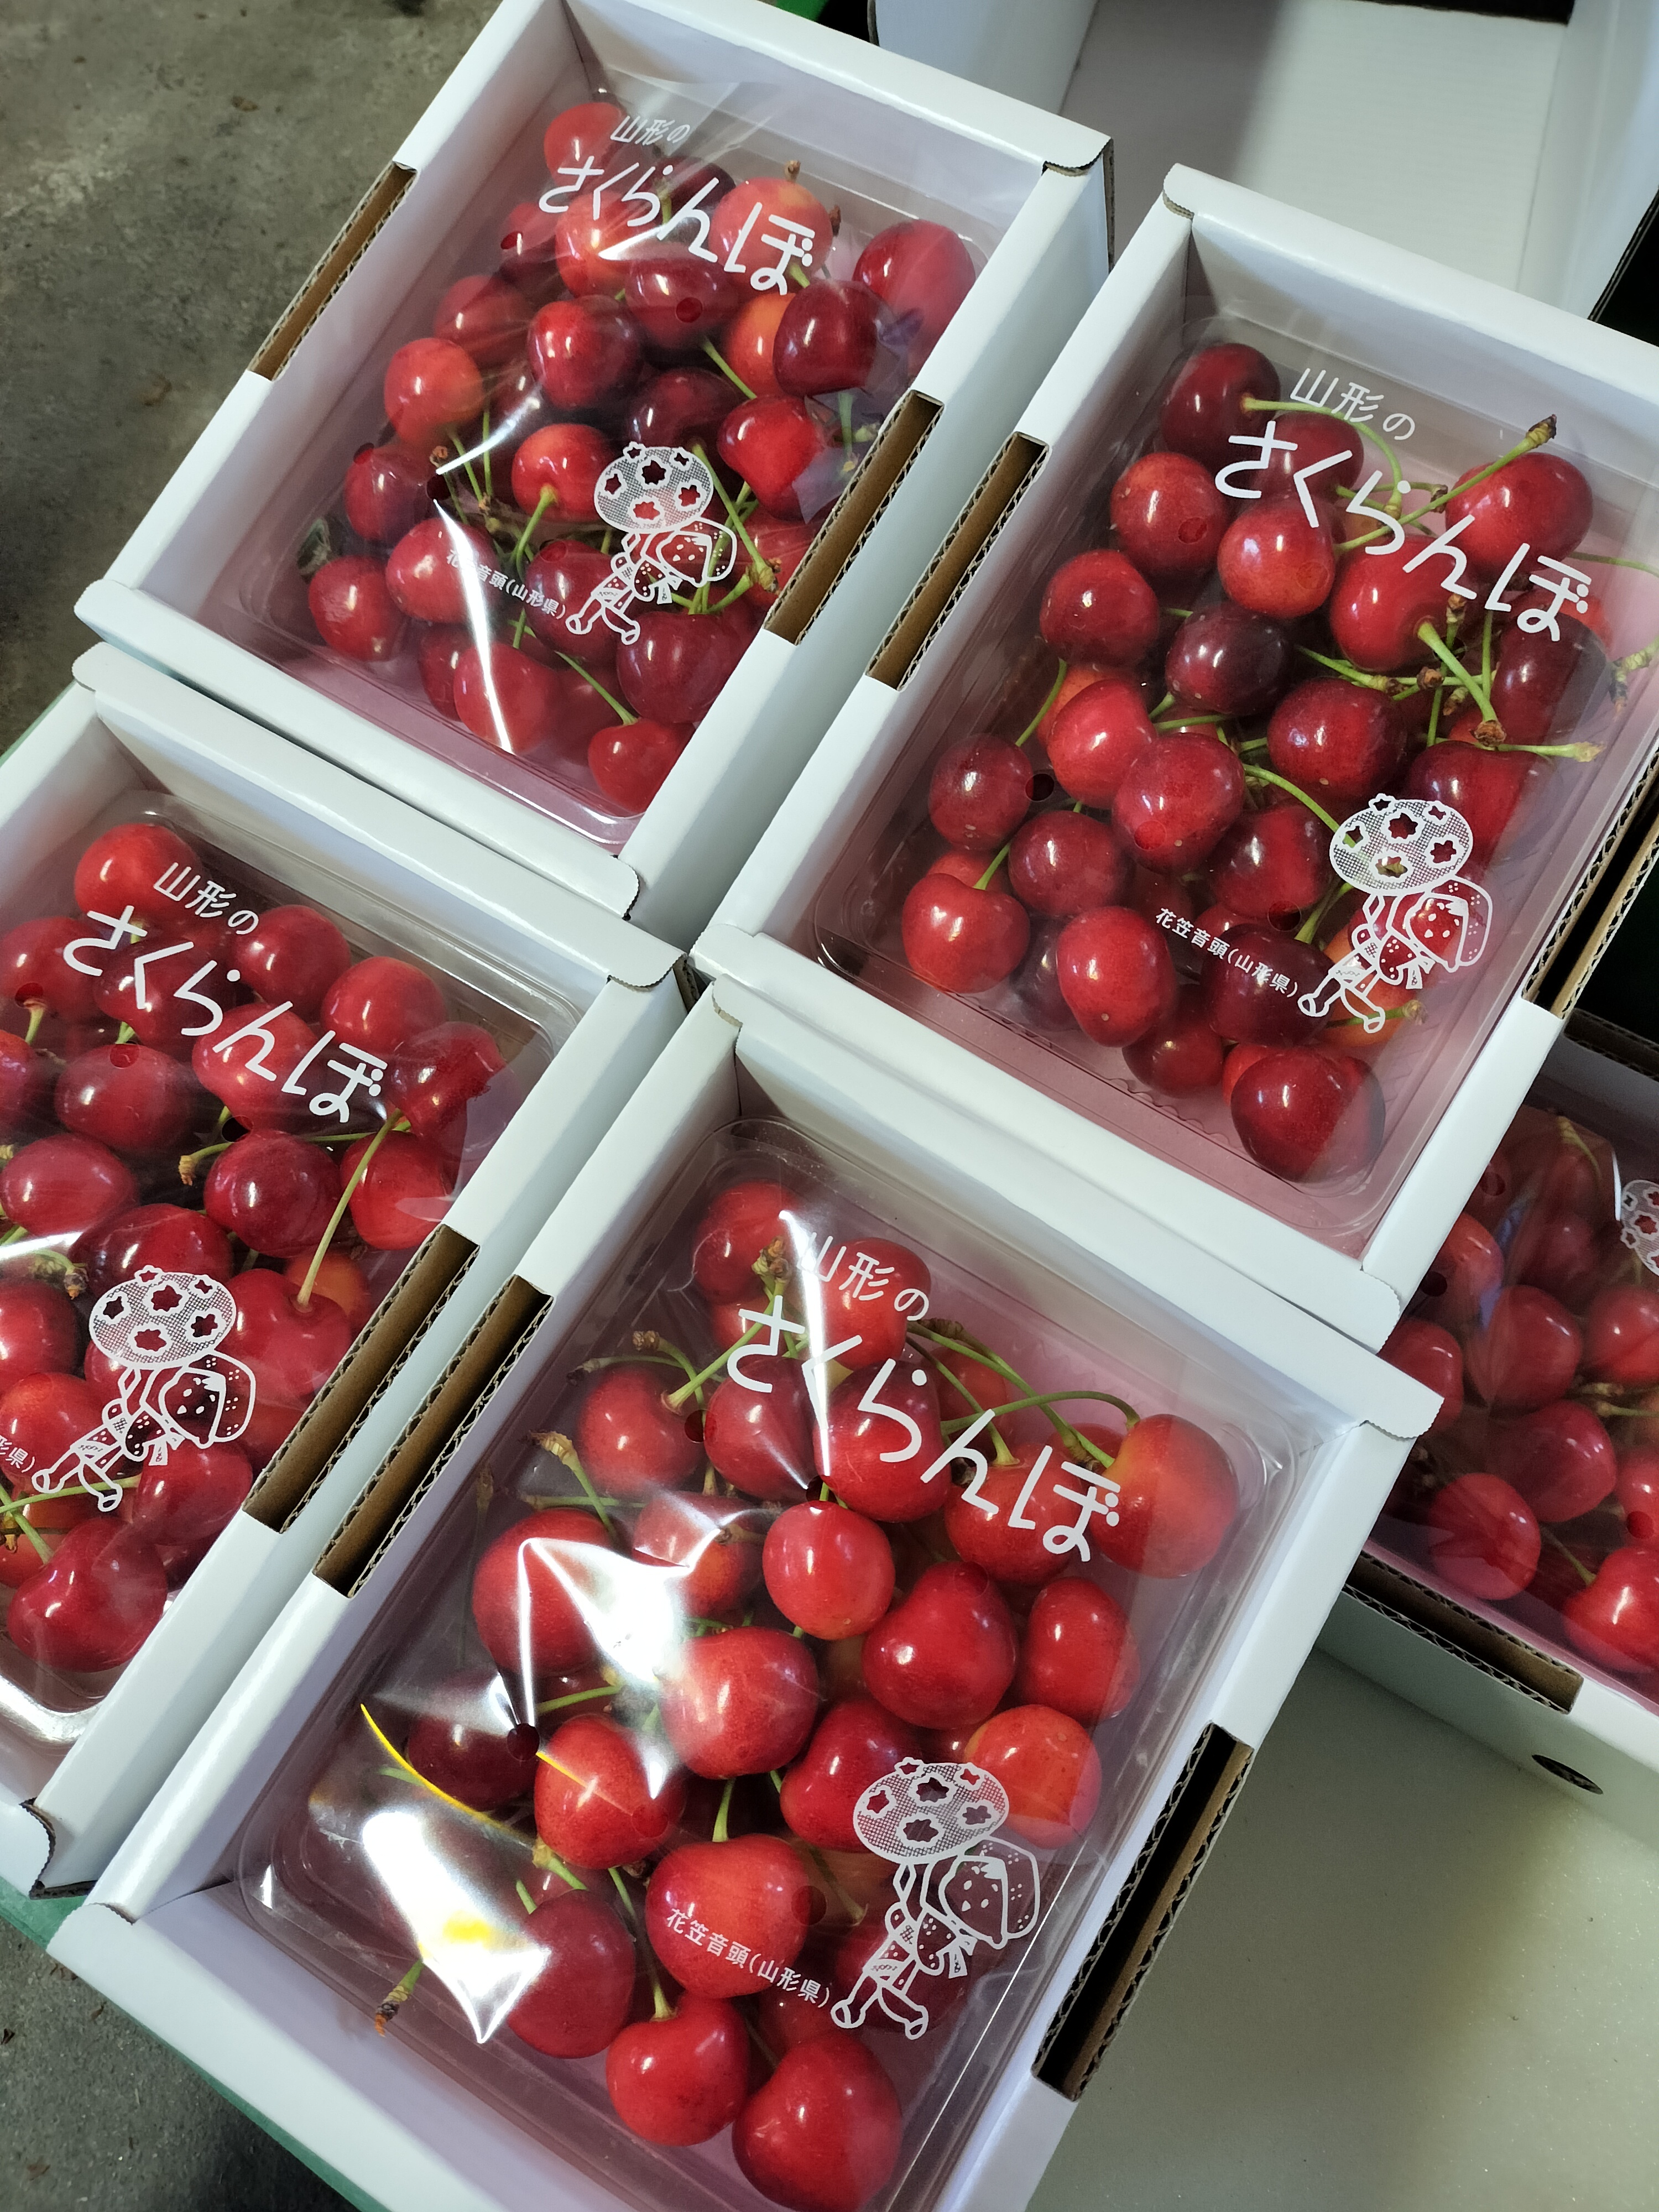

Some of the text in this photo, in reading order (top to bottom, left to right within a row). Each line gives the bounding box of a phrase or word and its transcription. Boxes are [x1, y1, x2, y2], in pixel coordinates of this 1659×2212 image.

[611, 116, 690, 145] 山形の
[539, 155, 815, 295] さくらんぼ
[1290, 368, 1416, 441] 山形の
[1215, 420, 1592, 642] さくらんぼ
[153, 862, 259, 935] 山形の
[1155, 907, 1299, 998] 花笠音頭(山形県)
[63, 905, 388, 1123] さくらんぼ
[796, 1232, 929, 1321] 山形の
[727, 1295, 1121, 1562] さくらんぼ
[666, 1908, 831, 2008] 花笠音頭(山形県)
